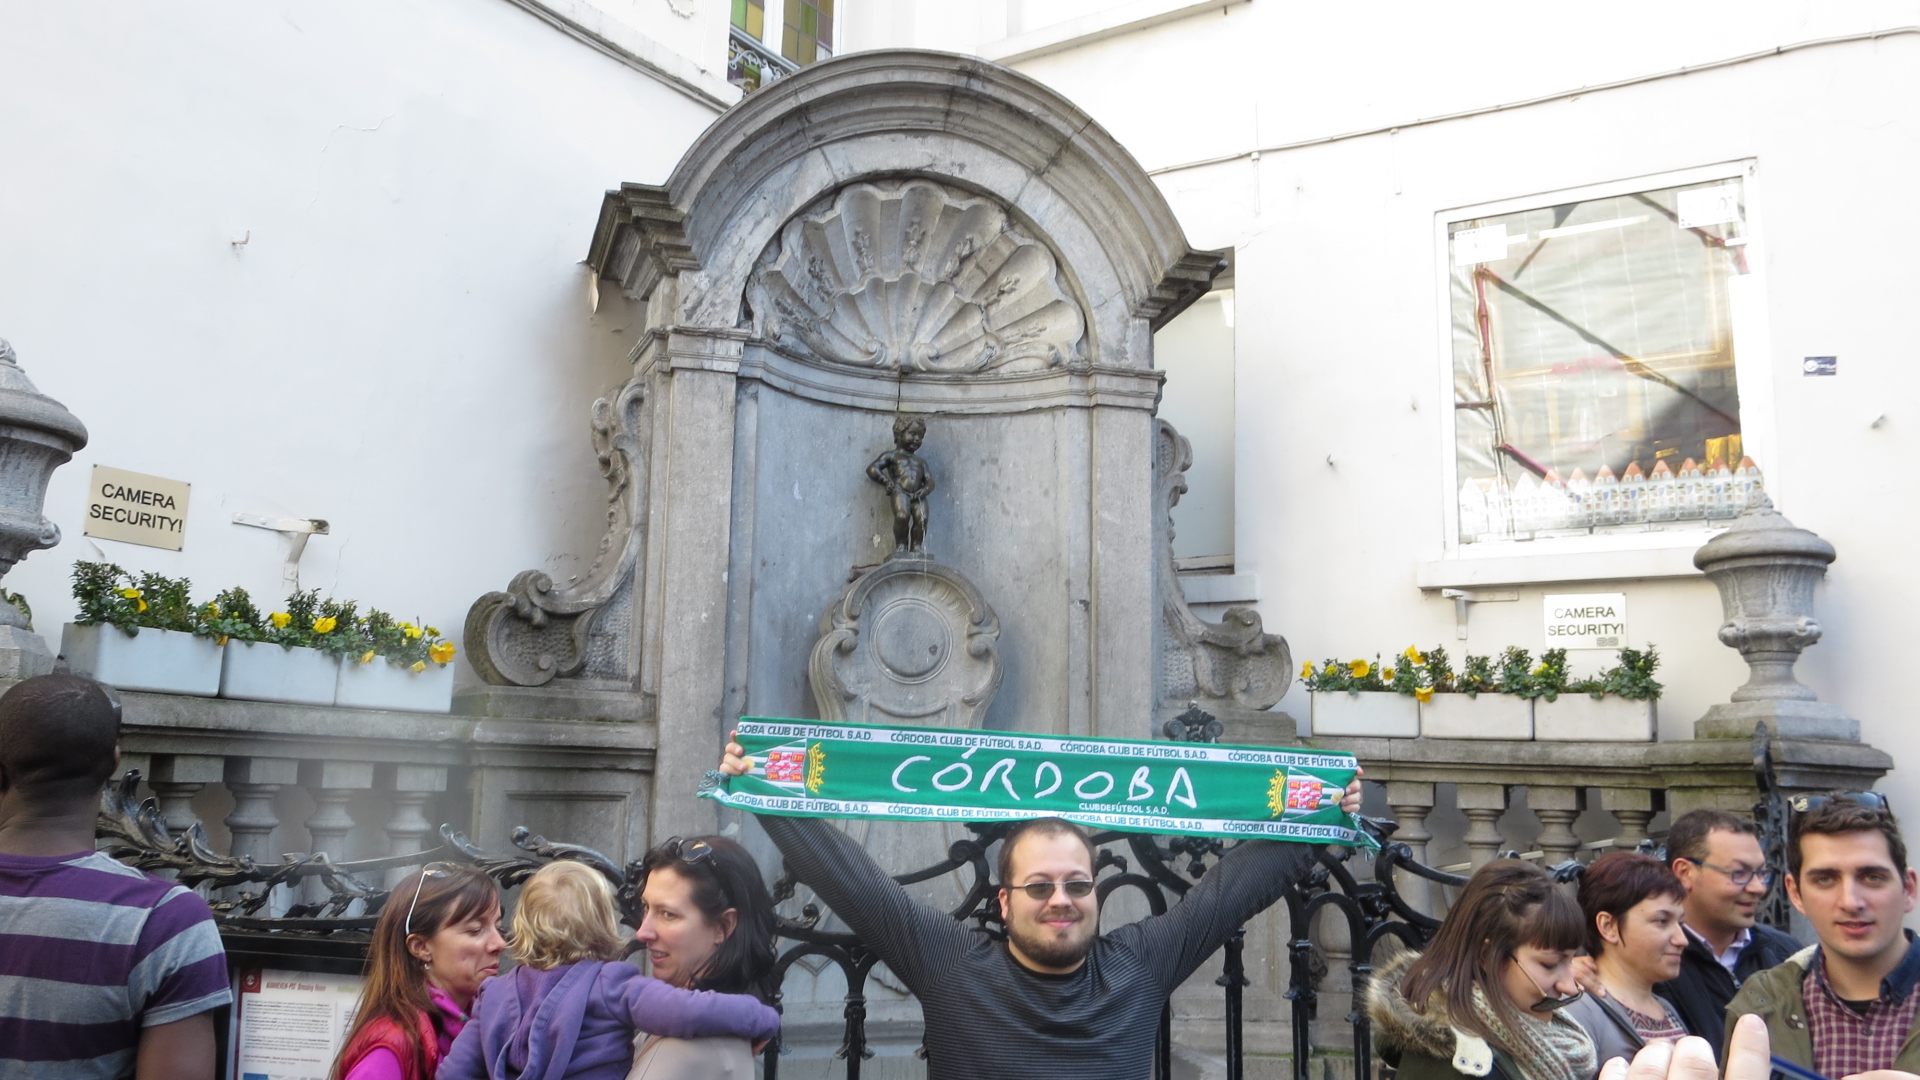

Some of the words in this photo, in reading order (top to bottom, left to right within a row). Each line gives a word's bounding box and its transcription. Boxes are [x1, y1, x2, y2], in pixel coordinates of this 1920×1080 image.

[101, 483, 176, 510] CAMERA
[90, 504, 183, 533] SECURITY!
[1554, 606, 1615, 619] CAMERA
[1548, 623, 1624, 636] SECURITY!
[768, 726, 790, 736] CLUB
[793, 727, 806, 737] DE
[808, 726, 844, 739] FÚTBOL
[847, 731, 873, 740] S.A.D.
[891, 731, 937, 744] CÓRDOBA
[940, 736, 962, 746] CLUB
[965, 737, 977, 747] DE
[980, 736, 1016, 749] FÚTBOL
[1018, 740, 1043, 750] S.A.D.
[1060, 741, 1105, 754] CÓRDOBA
[1108, 745, 1130, 755] CLUB
[1132, 746, 1144, 756] DE
[1147, 746, 1182, 758] FÚTBOL
[1184, 749, 1209, 760] S.A.D.
[1228, 750, 1272, 763] CÓRDOBA
[1274, 755, 1296, 765] CLUB
[1298, 756, 1310, 766] DE
[1312, 755, 1348, 768] FÚTBOL
[891, 747, 1197, 809] CÓRDOBA
[766, 798, 789, 809] CLUB
[791, 800, 804, 810] DE
[806, 798, 842, 812] FÚTBOL
[844, 804, 871, 813] S.A.D.
[888, 803, 934, 816] CÓRDOBA
[936, 808, 959, 817] CLUB
[961, 809, 974, 818] DE
[1146, 805, 1170, 815] S.A.D.
[1105, 815, 1127, 825] CLUB
[1128, 817, 1141, 826] DE
[1143, 816, 1178, 828] FÚTBOL
[1180, 819, 1204, 830] S.A.D.
[1223, 820, 1265, 834] CÓRDOBA
[1267, 824, 1287, 835] CLUB
[1289, 825, 1300, 835] DE
[1302, 824, 1333, 837] FÚTBOL
